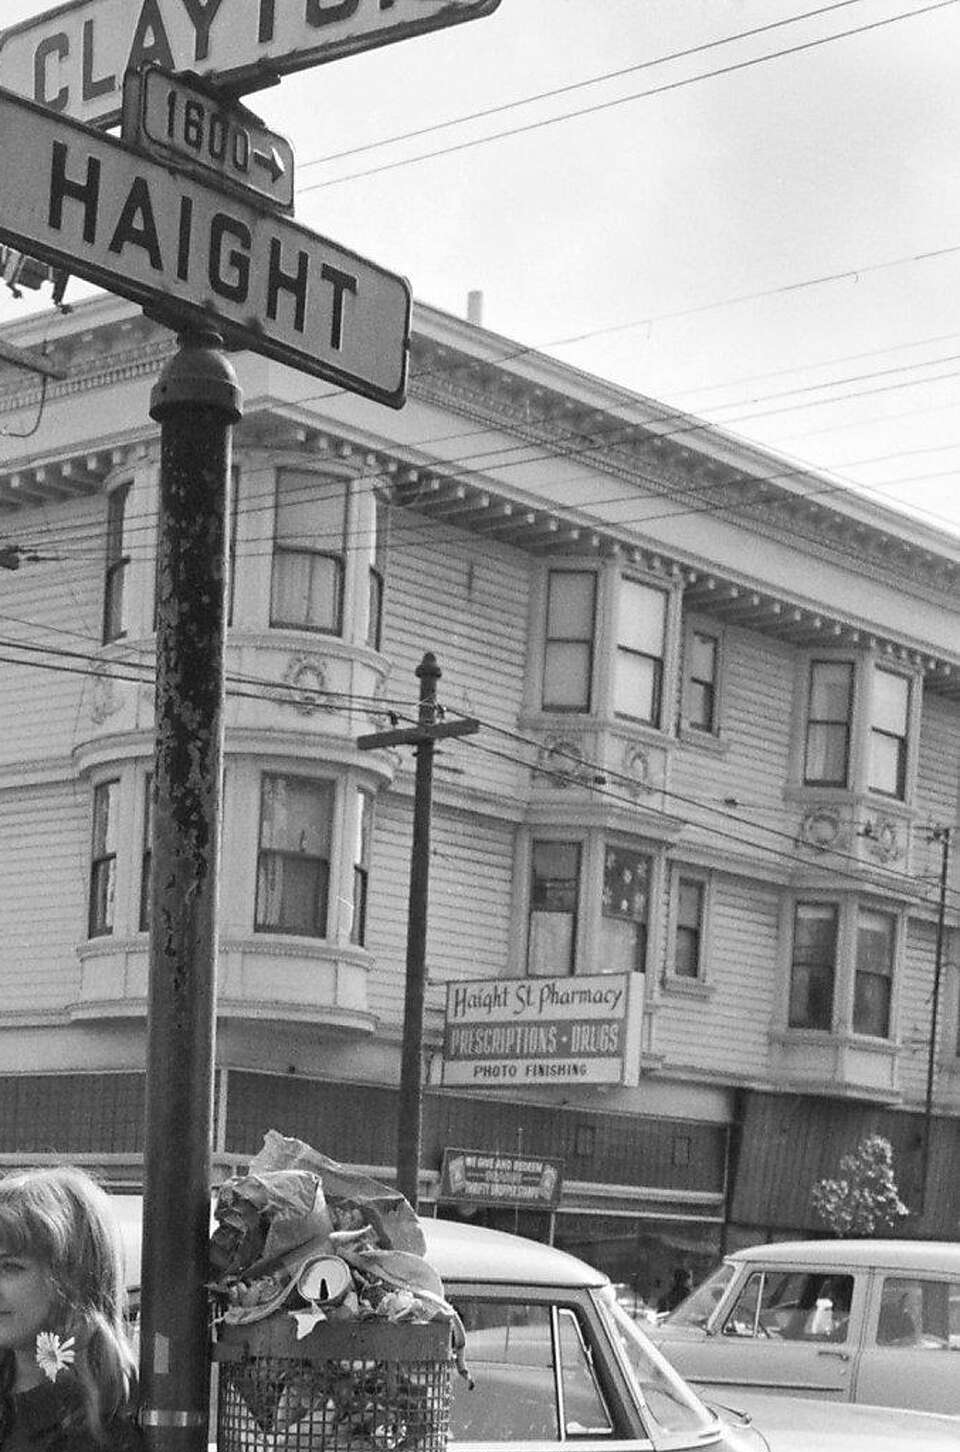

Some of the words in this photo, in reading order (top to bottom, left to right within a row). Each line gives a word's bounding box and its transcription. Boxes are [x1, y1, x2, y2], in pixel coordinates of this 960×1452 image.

[34, 0, 397, 112] CLAY
[167, 90, 251, 173] 1800
[48, 140, 357, 350] HAIGHT
[453, 984, 509, 1017] Haight
[539, 982, 622, 1014] Pharmacy
[450, 1026, 557, 1055] PRESCRIPTIONS
[571, 1024, 619, 1053] DRUGS
[473, 1065, 517, 1078] PHOTO
[525, 1063, 588, 1077] FINISHING
